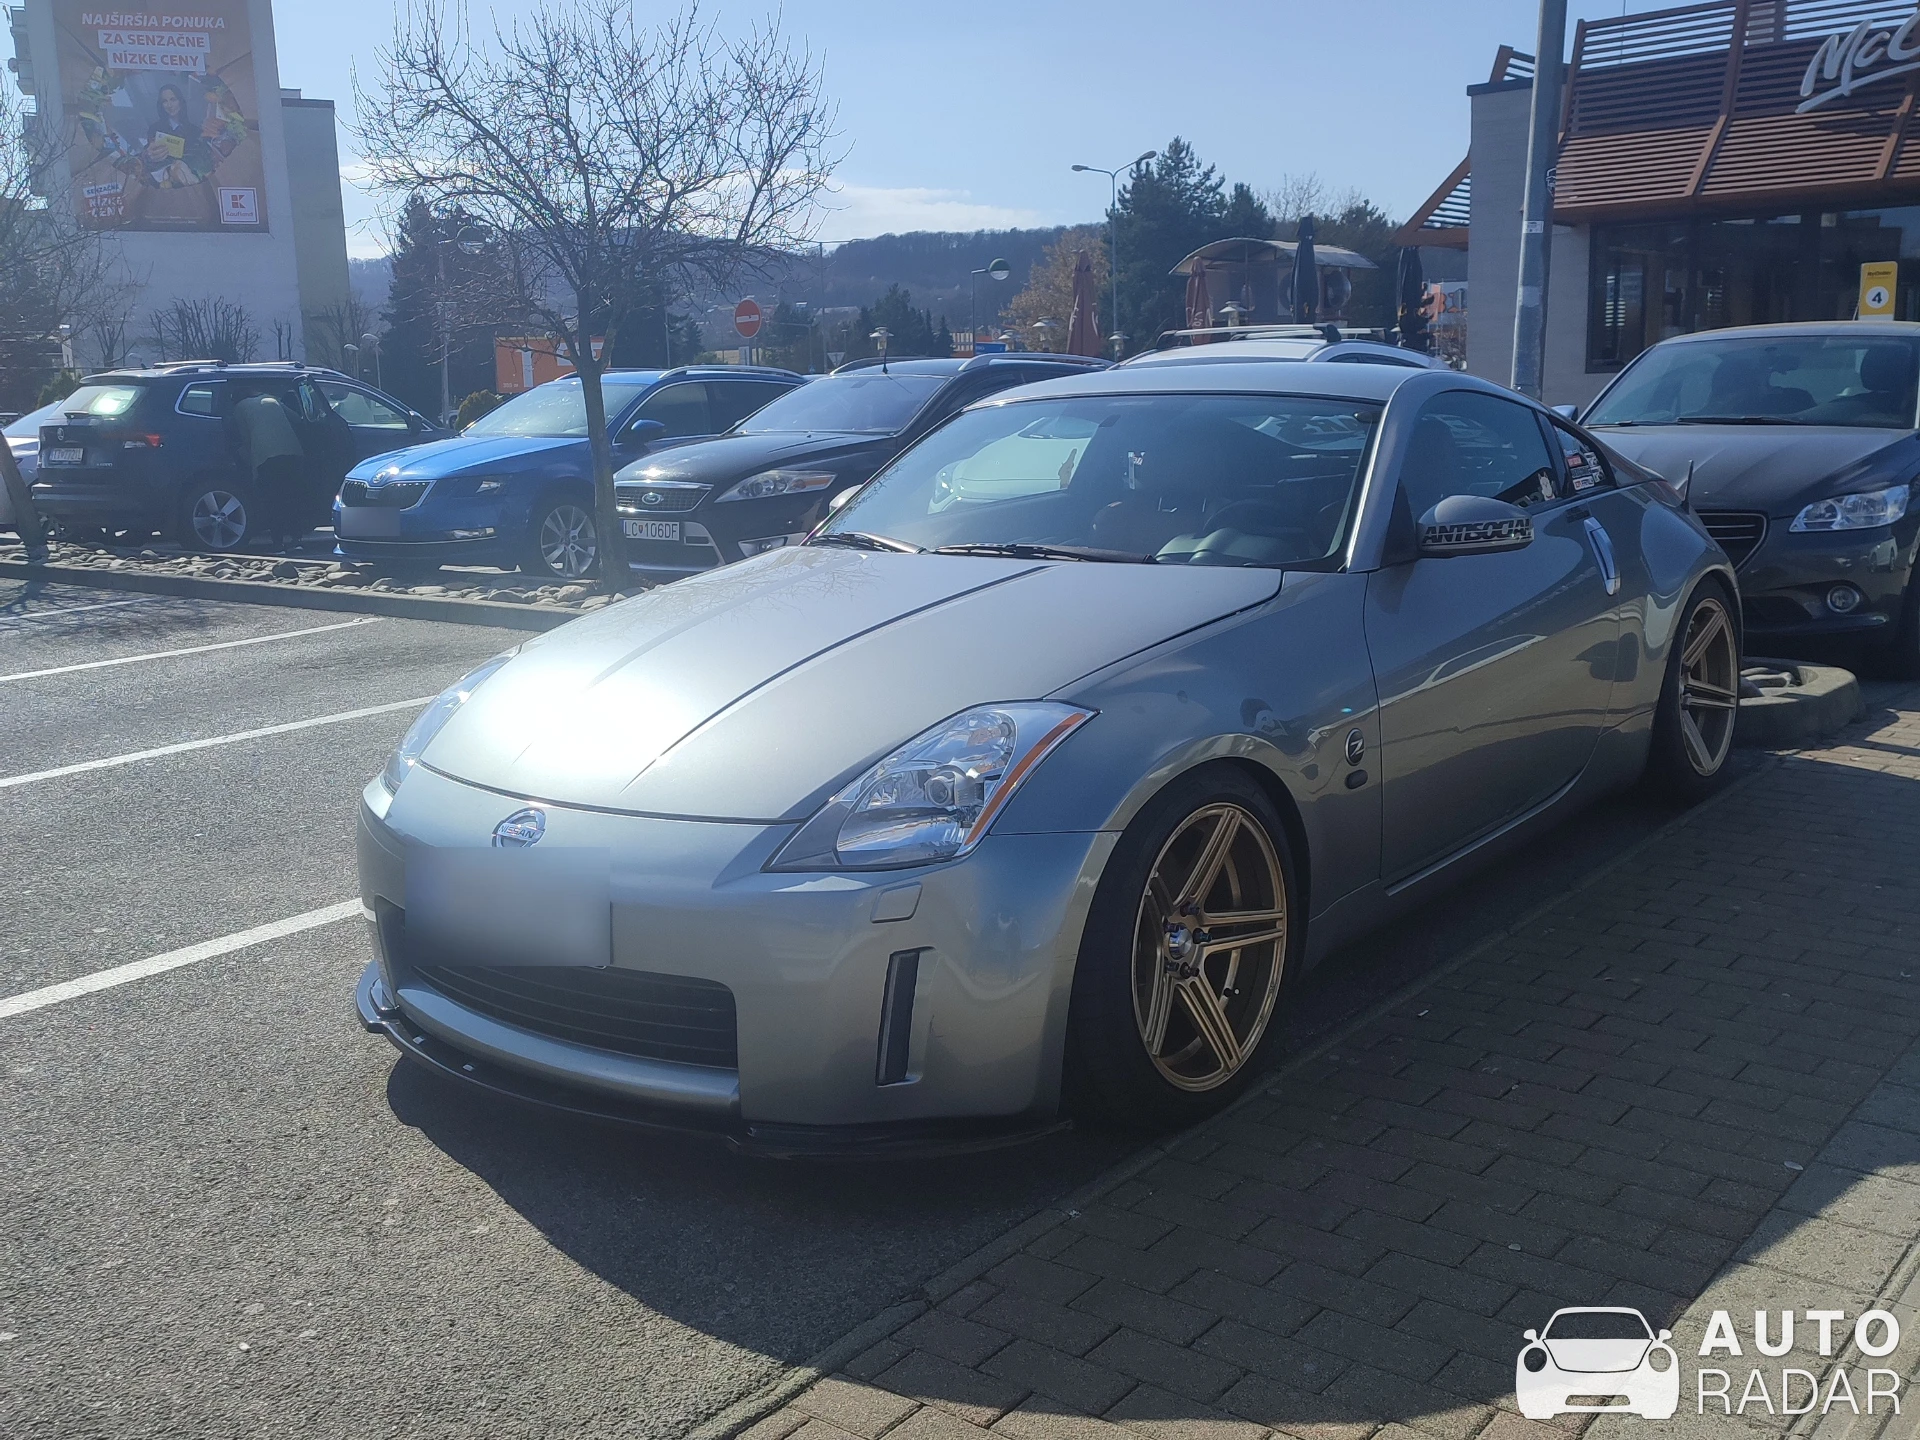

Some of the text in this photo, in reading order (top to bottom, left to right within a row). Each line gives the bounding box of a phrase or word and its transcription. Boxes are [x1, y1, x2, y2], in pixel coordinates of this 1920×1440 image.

[82, 12, 225, 29] NAJŠIRŠIA PONUKA
[103, 32, 205, 48] ZA SENZAČNE
[112, 50, 199, 67] NÍZKE CENY
[1871, 291, 1883, 304] 4
[624, 521, 678, 539] LC 106DF
[499, 825, 536, 839] NISSAN
